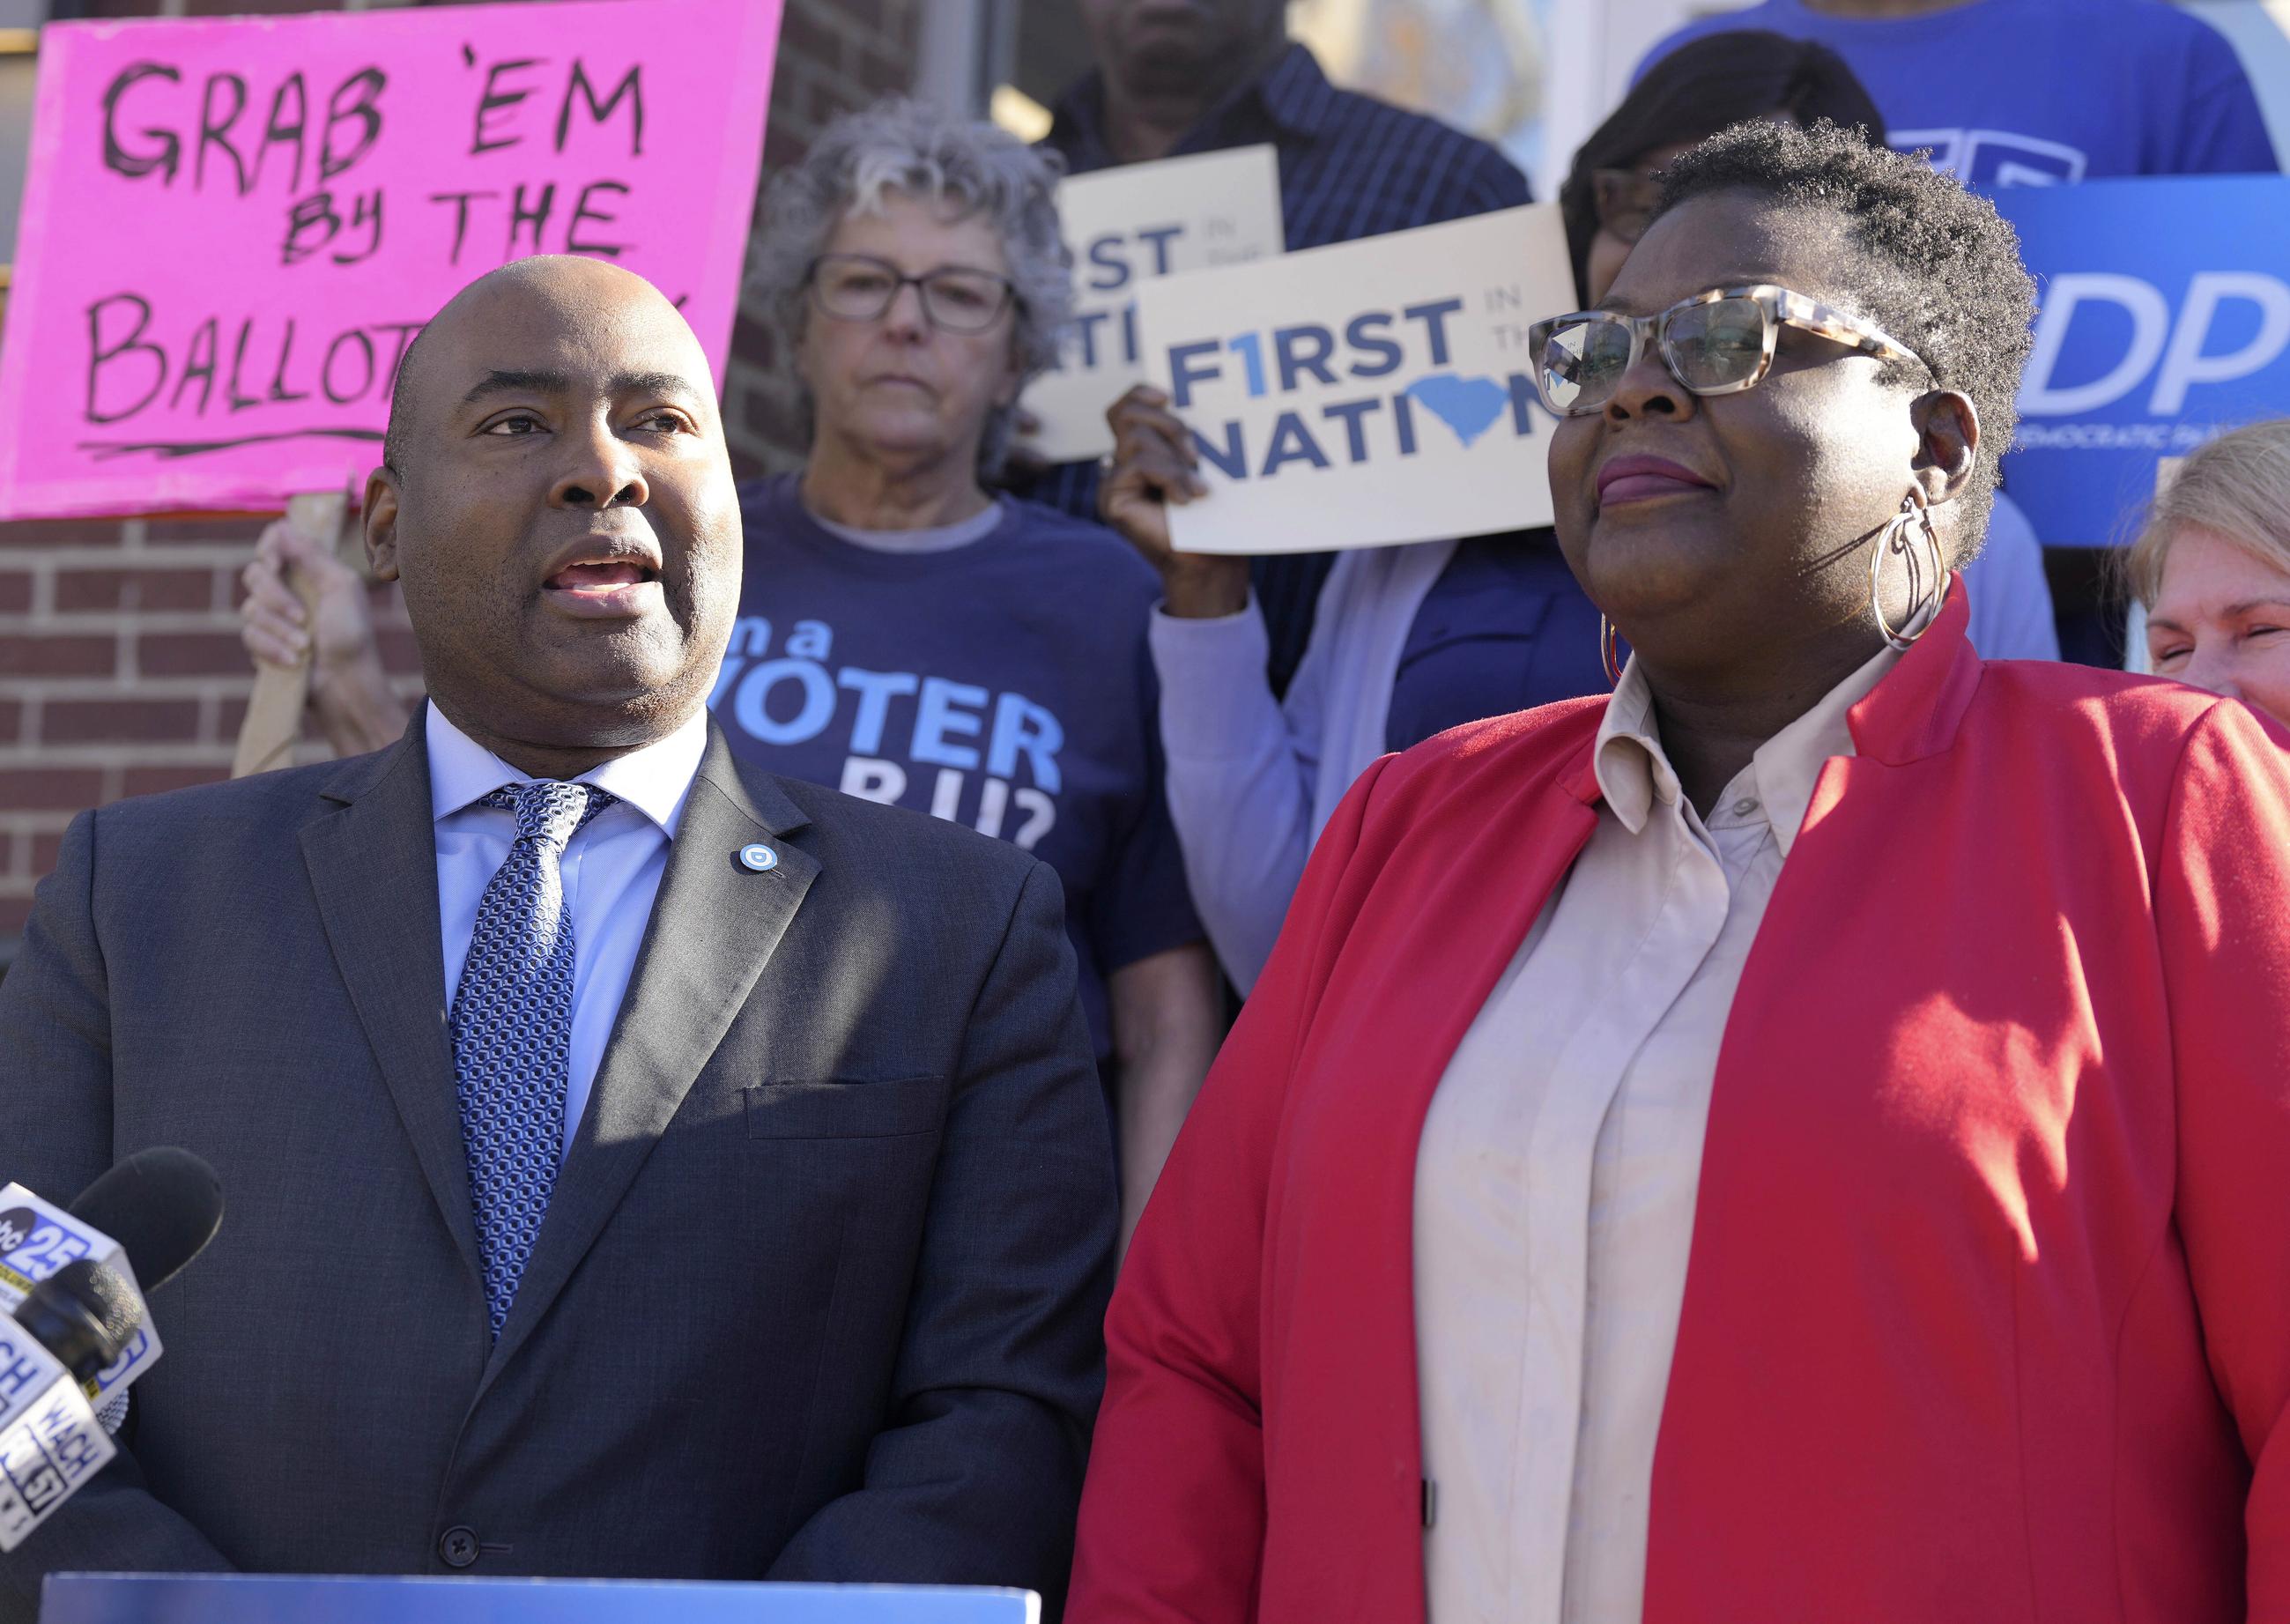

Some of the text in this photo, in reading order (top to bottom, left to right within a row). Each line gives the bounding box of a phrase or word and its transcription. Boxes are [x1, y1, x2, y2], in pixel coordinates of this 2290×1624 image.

[102, 43, 647, 197] GRAB 'EM
[282, 182, 634, 265] BY THE
[1485, 284, 1523, 314] IN
[785, 619, 833, 661] a
